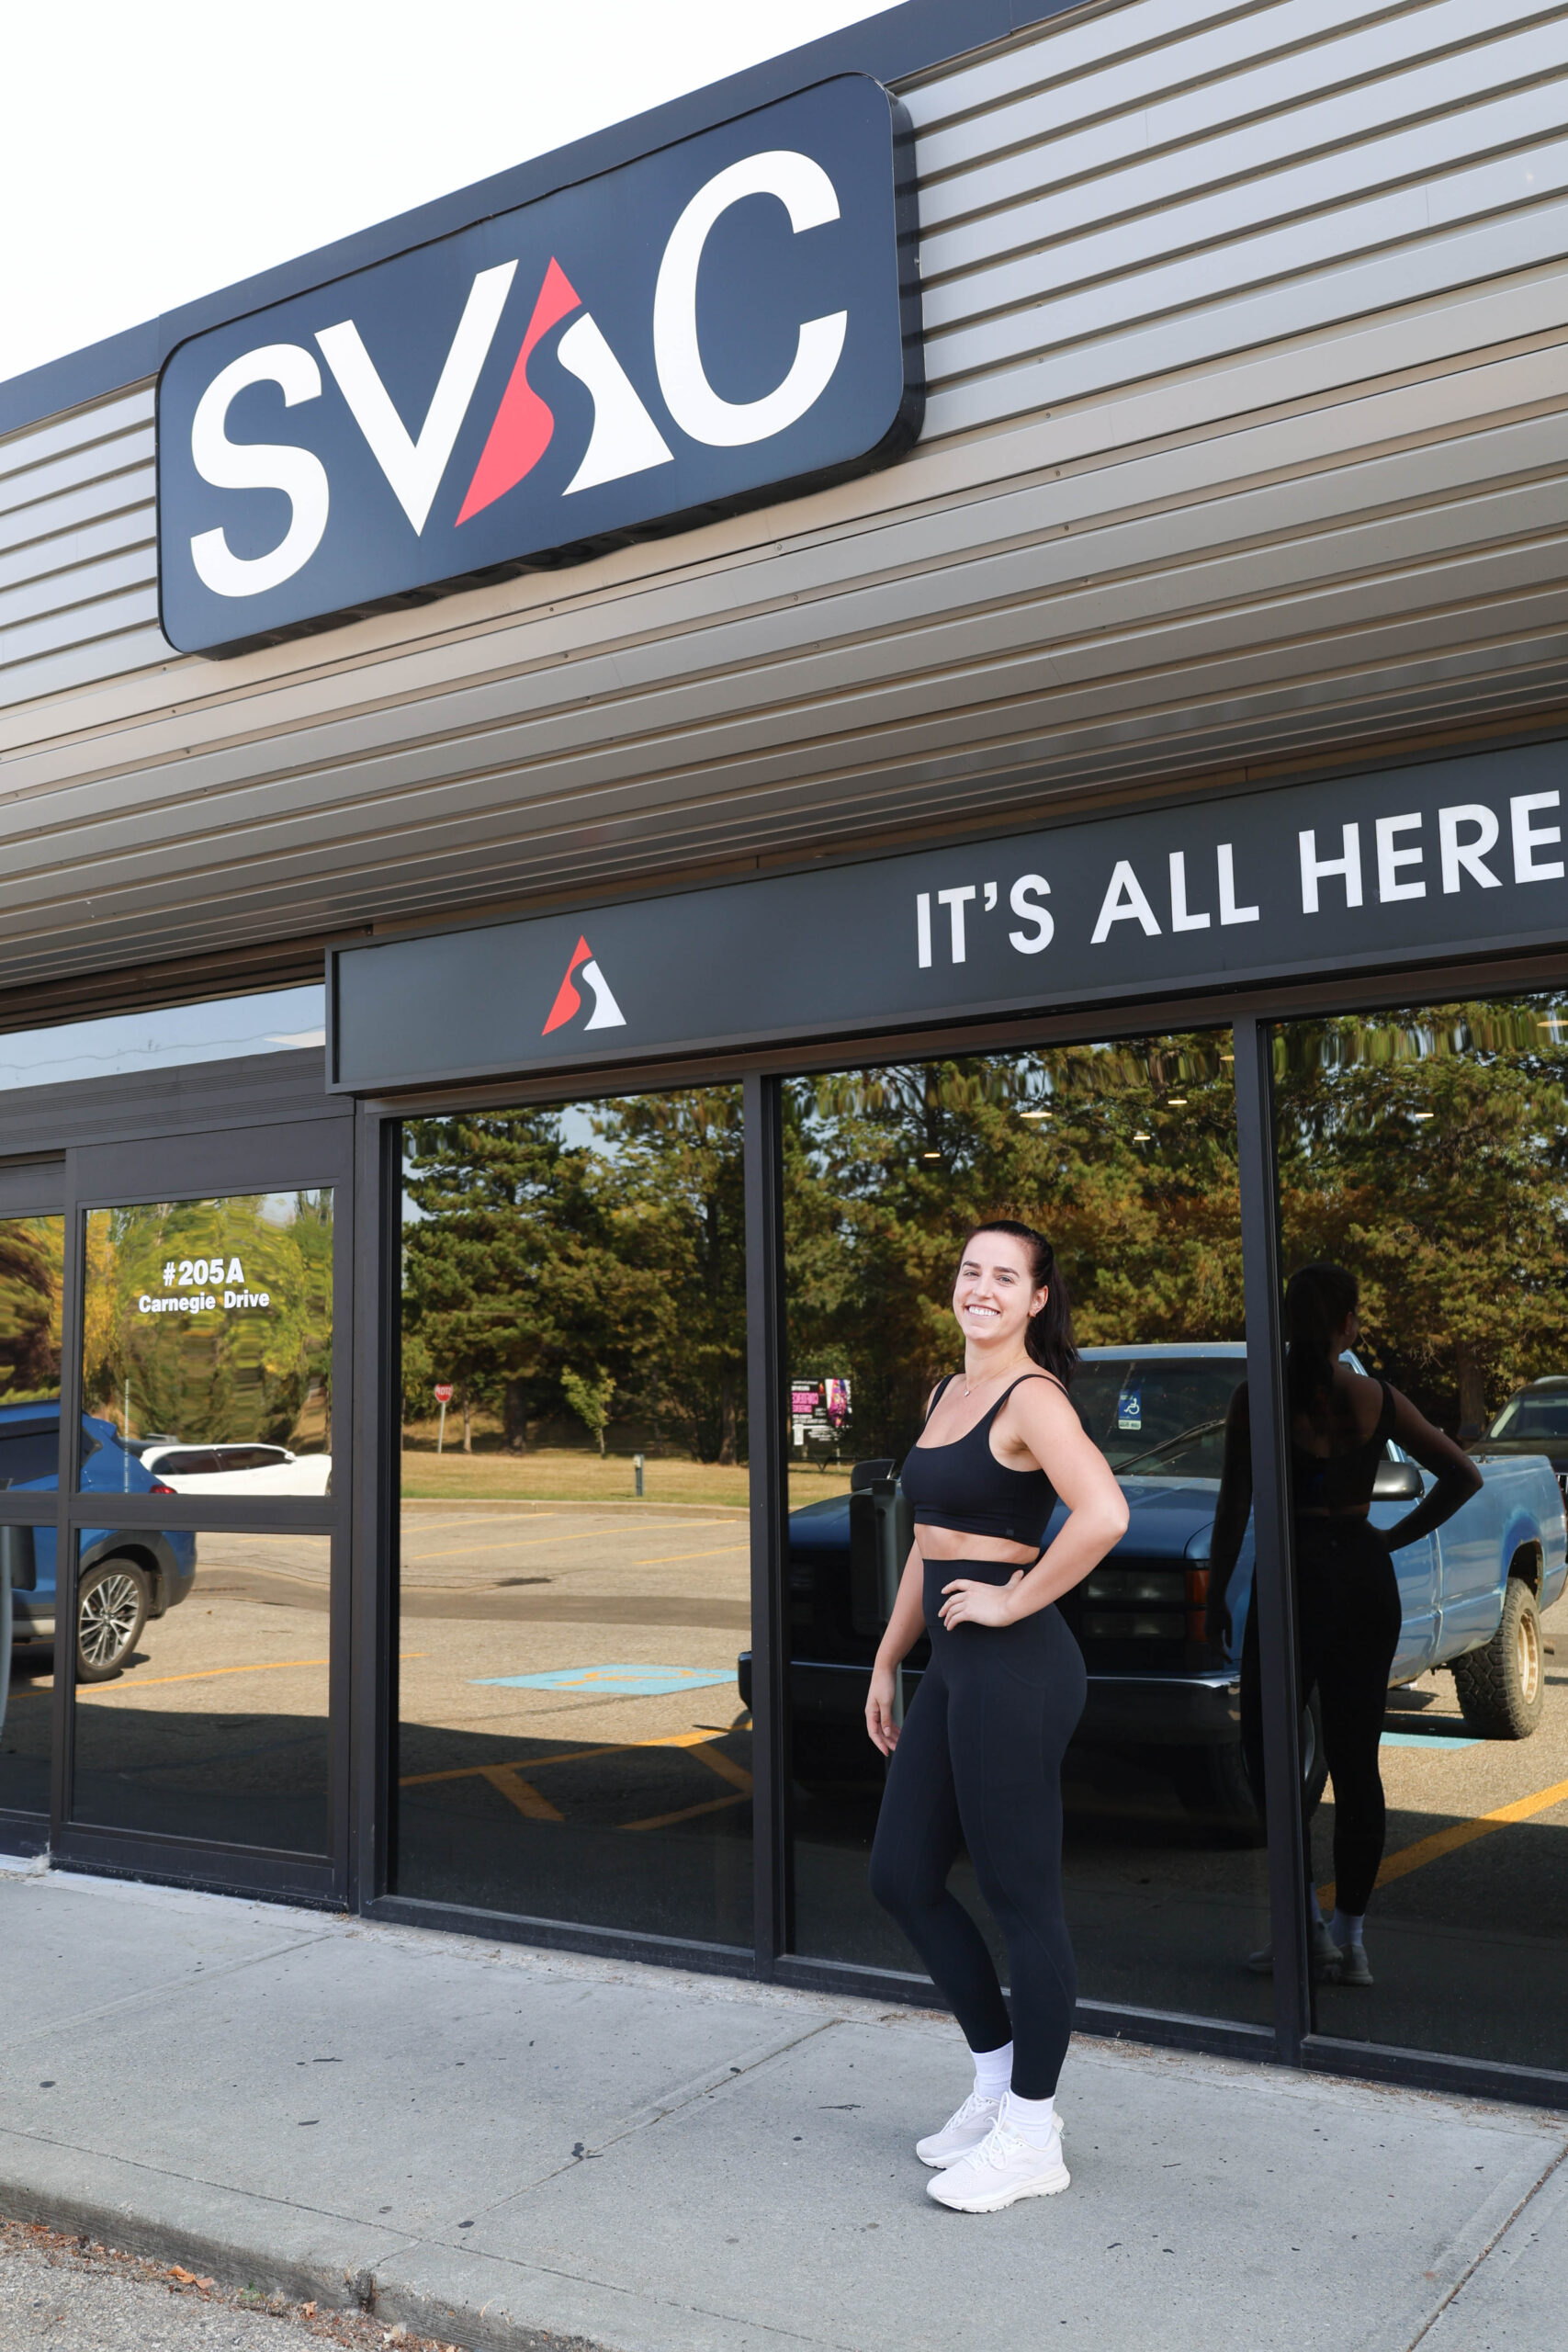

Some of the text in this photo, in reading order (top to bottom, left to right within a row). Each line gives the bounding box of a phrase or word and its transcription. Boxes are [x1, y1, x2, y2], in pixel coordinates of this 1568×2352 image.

[190, 149, 849, 598] SVAC
[916, 789, 1567, 969] IT'S ALL HERE
[138, 1288, 271, 1315] Carnegie Drive
[163, 1257, 245, 1287] #205A
